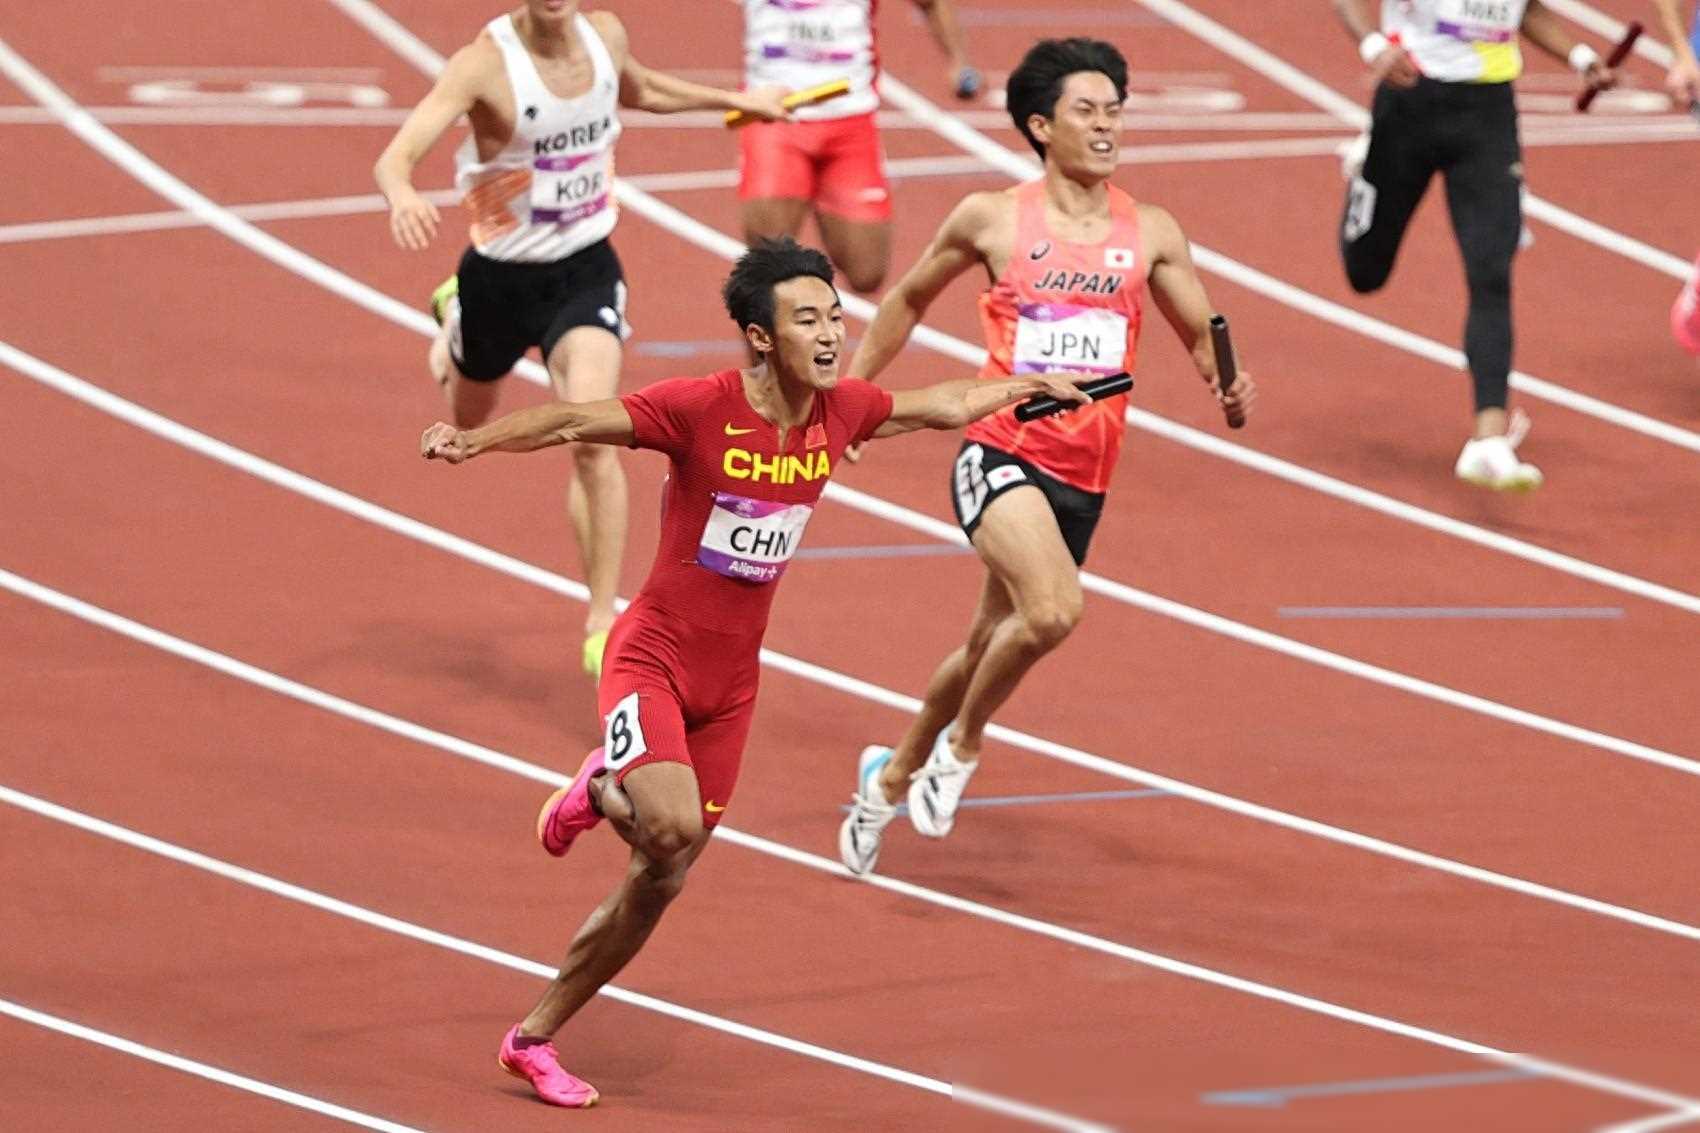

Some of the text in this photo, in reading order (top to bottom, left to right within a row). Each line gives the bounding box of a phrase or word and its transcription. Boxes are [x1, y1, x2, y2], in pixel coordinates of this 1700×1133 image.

[534, 117, 611, 155] KOREA
[1033, 269, 1123, 295] JAPAN
[1041, 331, 1101, 360] JPN
[723, 447, 832, 485] CHINA
[730, 525, 792, 557] CHN
[611, 709, 633, 762] 8
